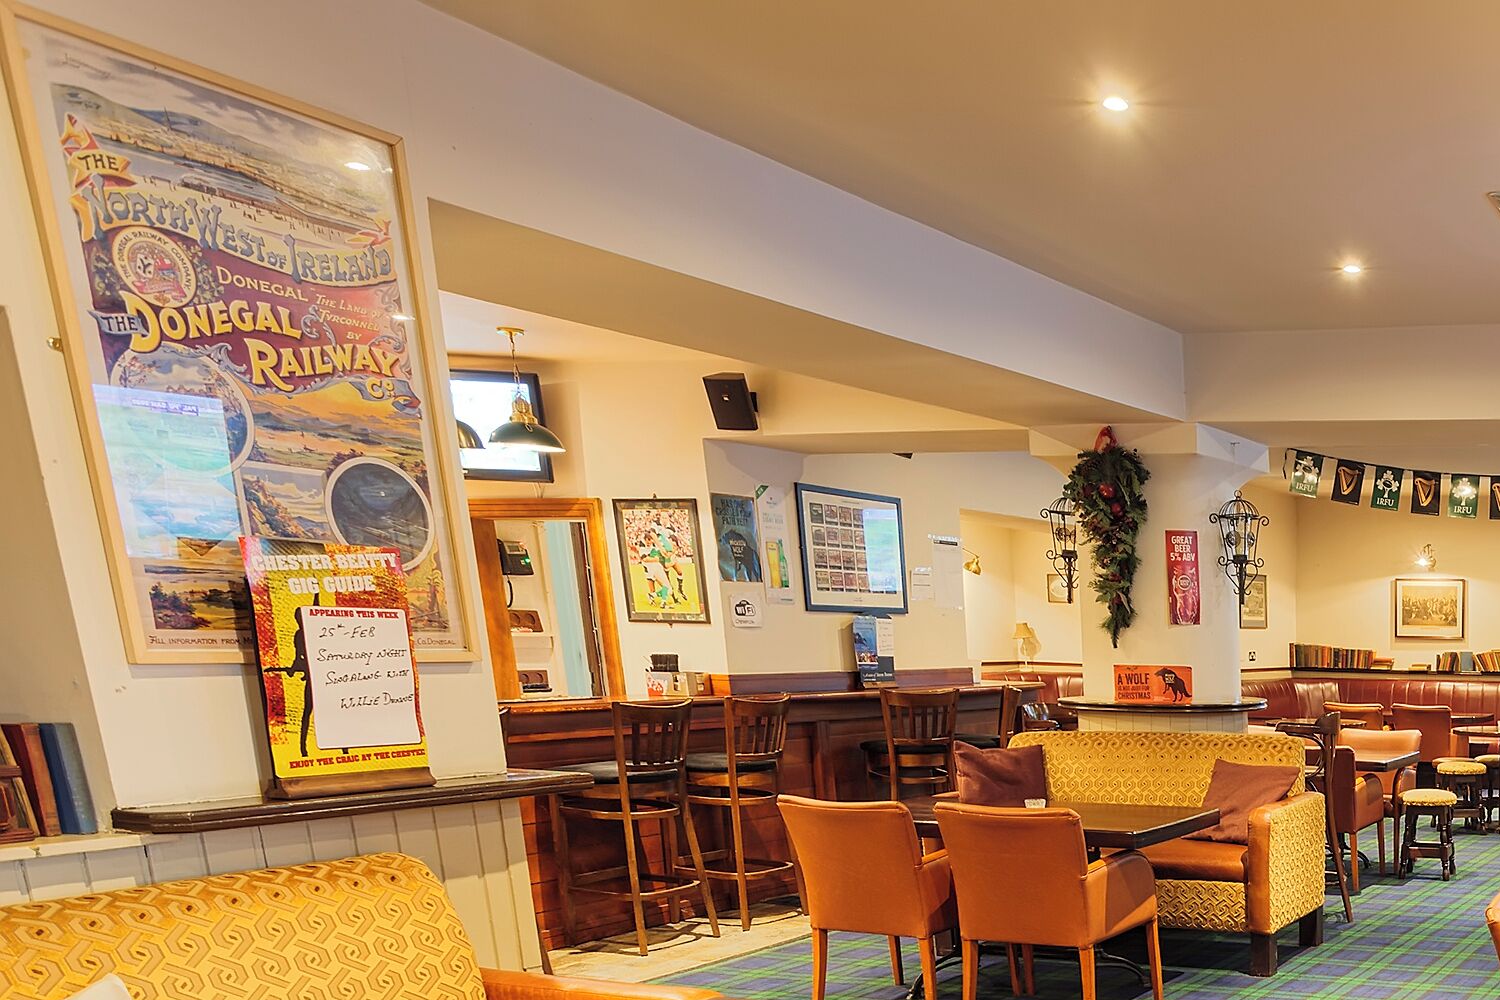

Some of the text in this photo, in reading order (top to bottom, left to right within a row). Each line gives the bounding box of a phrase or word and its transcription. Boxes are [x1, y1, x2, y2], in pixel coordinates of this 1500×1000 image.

[77, 154, 119, 171] THE
[132, 230, 169, 246] RAILWAY
[283, 234, 391, 284] IRELAND
[216, 266, 308, 302] DONEGAL
[339, 300, 368, 315] LAND
[101, 290, 301, 353] THE DONEGAL
[346, 331, 362, 340] BY
[244, 337, 400, 392] RAILWAY
[1295, 481, 1314, 493] IRFU
[1376, 497, 1395, 507] IRFU
[1454, 505, 1473, 515] IRFU
[1171, 536, 1193, 545] GREAT
[1174, 544, 1191, 553] BEER
[250, 553, 398, 572] CHESTER BEATTY
[1170, 552, 1195, 562] 5% ABV
[288, 575, 376, 594] GIG GUIDE
[309, 608, 399, 619] APPEARING THIS WEEK
[169, 638, 218, 646] INFORMATION
[1124, 673, 1150, 685] WOLF
[1117, 691, 1151, 700] CHRISTMAS
[289, 756, 315, 769] ENJOY
[316, 756, 334, 766] THE
[336, 753, 361, 764] CRAIC
[361, 753, 372, 761] AT
[373, 751, 391, 761] THE
